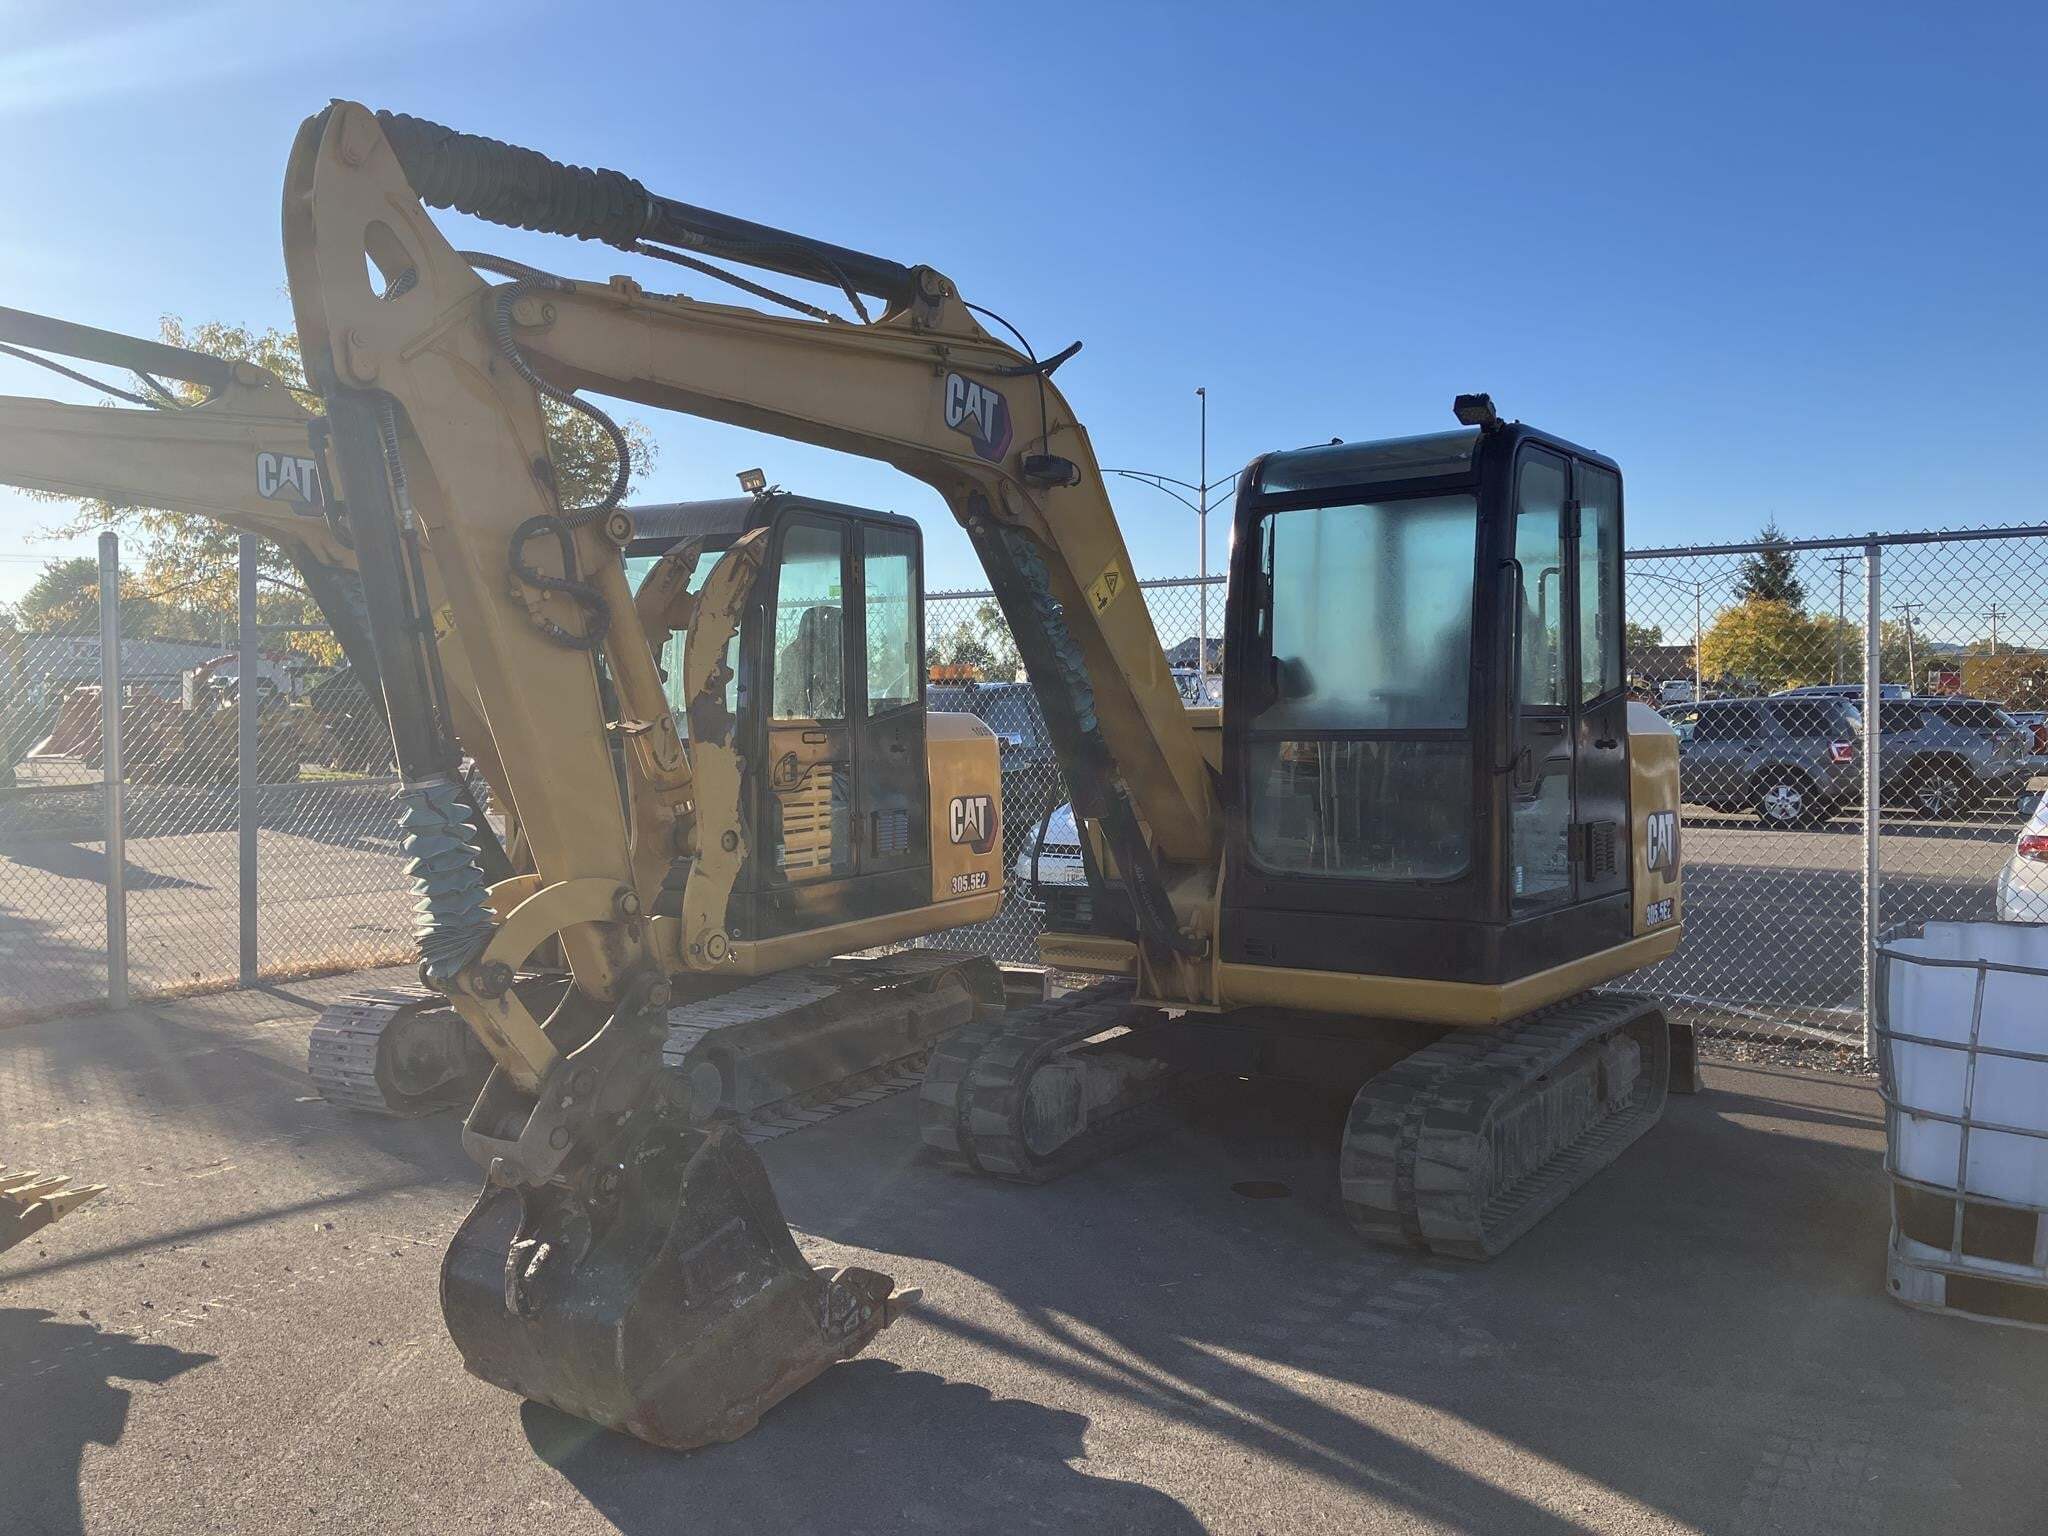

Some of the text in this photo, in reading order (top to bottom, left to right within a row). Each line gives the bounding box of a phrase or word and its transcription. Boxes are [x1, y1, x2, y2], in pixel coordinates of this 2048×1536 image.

[946, 373, 999, 443] CAT
[257, 452, 316, 503] CAT
[950, 797, 987, 843] CAT
[1647, 813, 1674, 869] CAT
[951, 873, 987, 894] 305.5E2
